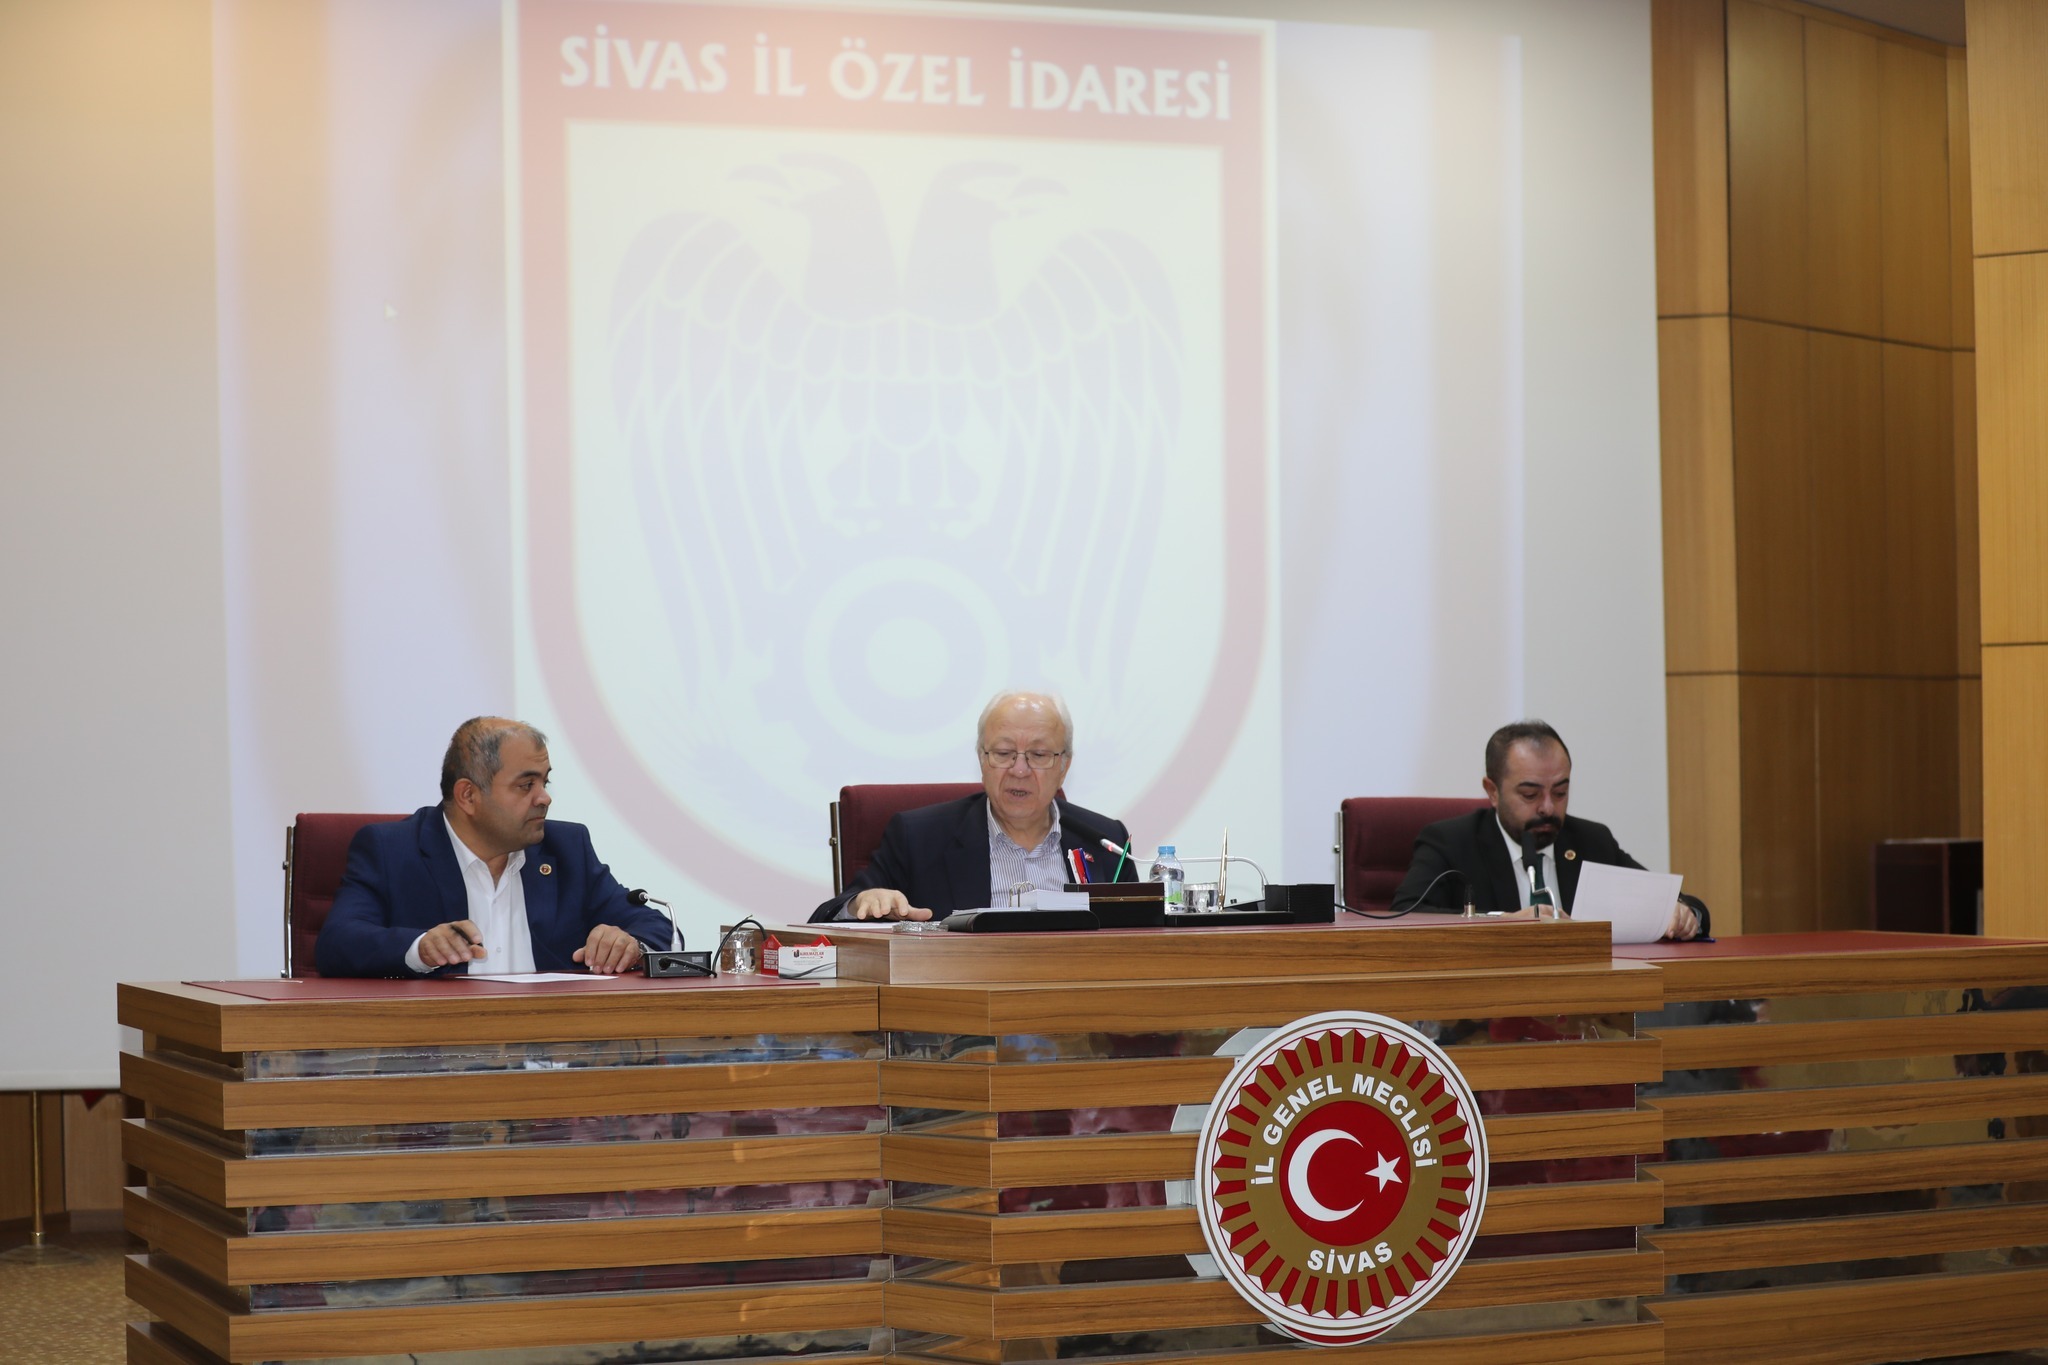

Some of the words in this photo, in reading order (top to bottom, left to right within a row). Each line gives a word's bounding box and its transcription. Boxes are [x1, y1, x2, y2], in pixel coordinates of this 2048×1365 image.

[559, 24, 728, 93] SİVAS
[753, 32, 806, 97] İL
[829, 37, 985, 107] ÖZEL
[1008, 46, 1231, 120] İDARESİ
[1250, 1156, 1274, 1185] İL
[1262, 1074, 1343, 1145] GENEL
[1351, 1073, 1438, 1168] MECLİSİ
[1307, 1241, 1393, 1274] SİVAS
